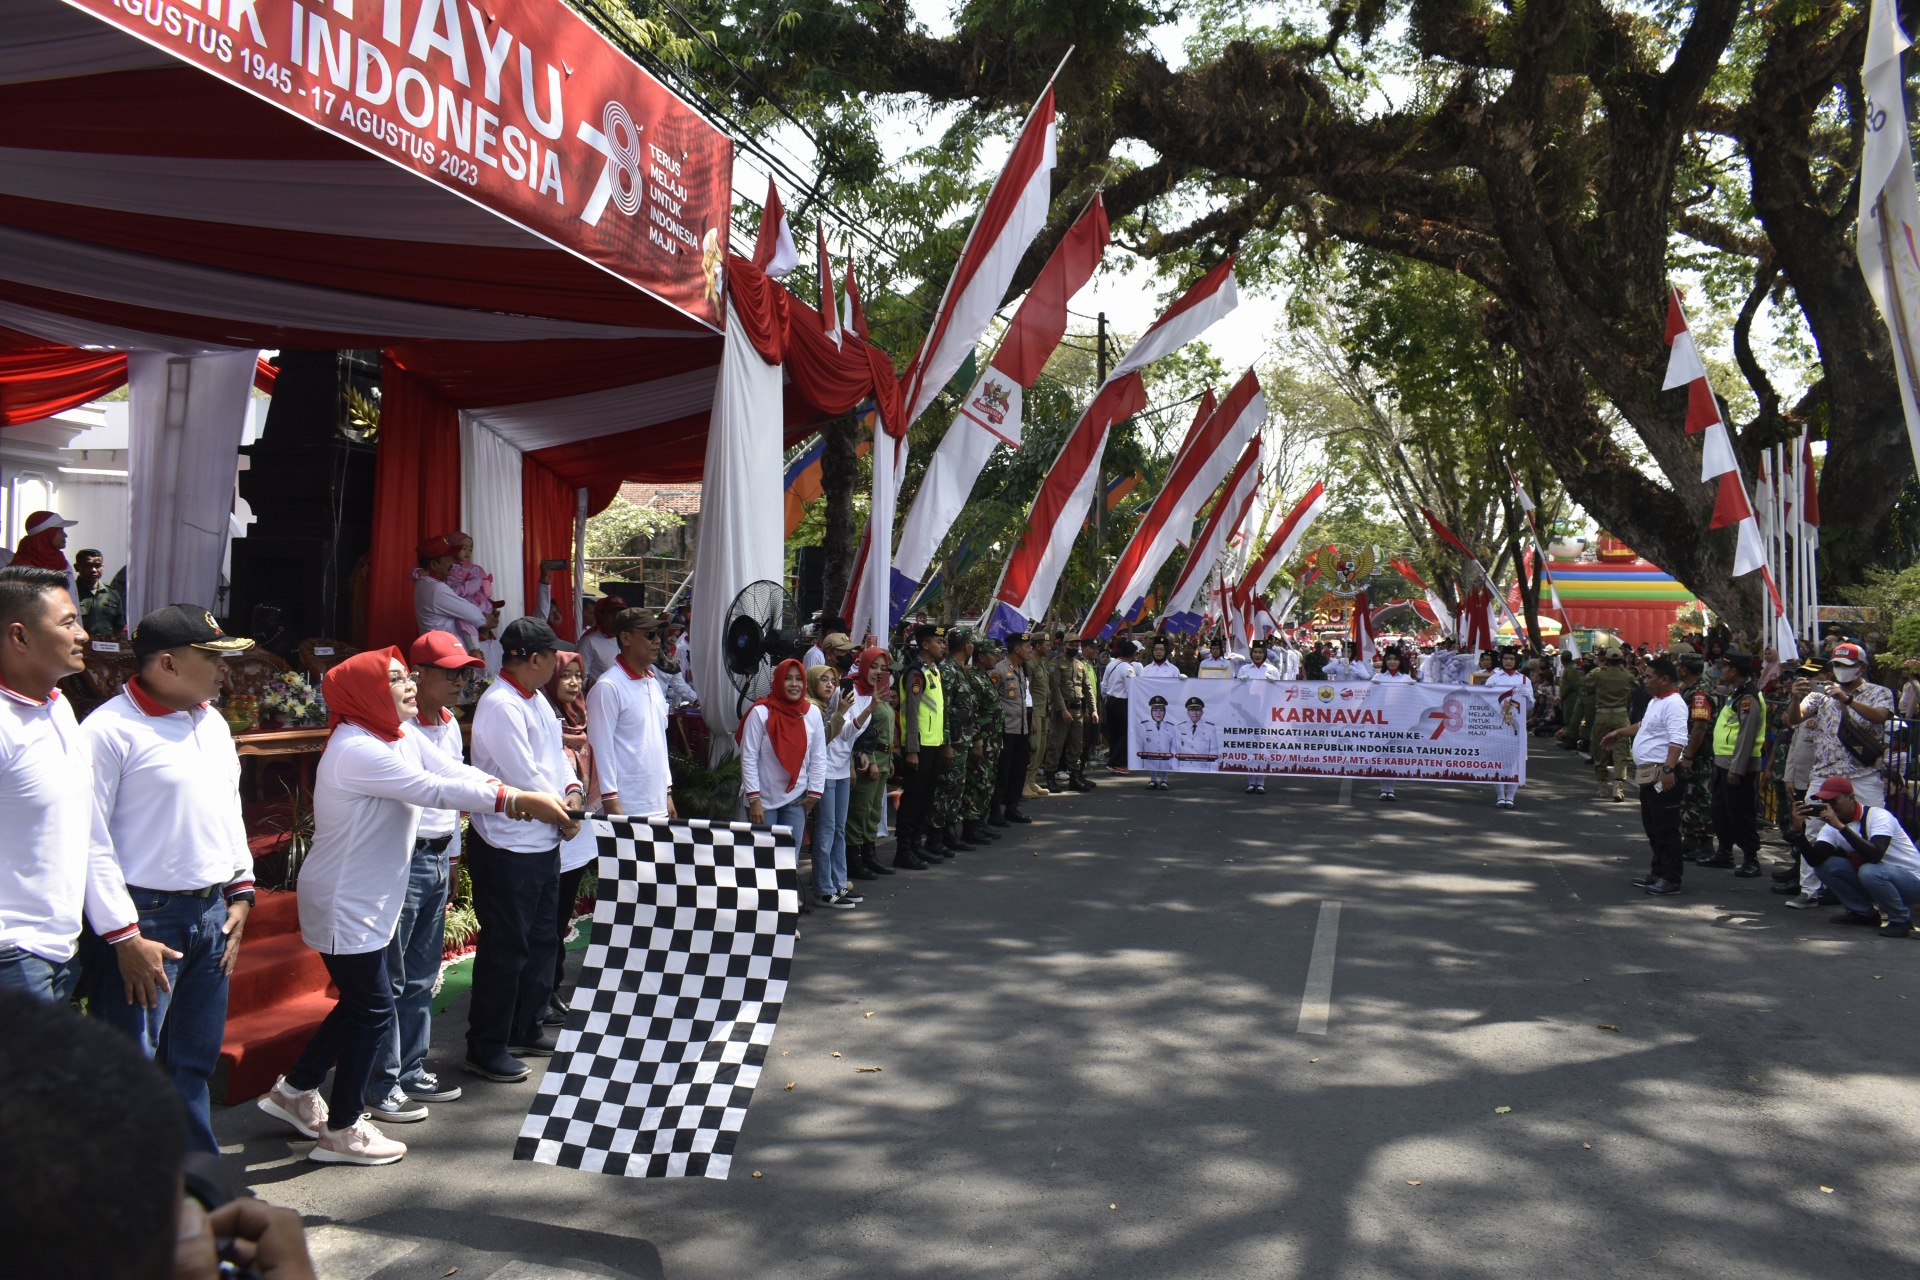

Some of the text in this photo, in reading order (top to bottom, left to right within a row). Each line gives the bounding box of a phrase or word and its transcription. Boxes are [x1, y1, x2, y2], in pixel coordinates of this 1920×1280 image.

[240, 47, 292, 94] 1945
[311, 86, 336, 114] 17
[340, 100, 435, 165] AGUSTUS
[440, 149, 478, 187] 2023
[290, 1, 564, 205] INDONESIA
[576, 100, 643, 227] 78
[648, 142, 681, 178] TERUS
[650, 163, 688, 202] MELAJU
[650, 184, 682, 219] UNTUK
[649, 226, 676, 255] MAJU
[650, 204, 699, 250] INDONESIA
[1223, 727, 1424, 740] MEMPERINGATI HARI ULANG TAHUN KE-
[1271, 707, 1389, 725] KARNAVAL
[1428, 699, 1464, 740] 78
[1222, 752, 1250, 761] PAUD,
[1253, 753, 1268, 762] TK,
[1270, 754, 1286, 763] SD/
[1303, 754, 1320, 763] dan
[1322, 755, 1347, 764] SMP/
[1349, 756, 1369, 764] MTs
[1371, 757, 1382, 765] SE
[1384, 757, 1443, 767] KABUPATEN
[1445, 760, 1502, 769] GROBOGAN
[1223, 740, 1480, 756] KEMERDEKAAN REPUBLIK INDONESIA TAHUN 2023
